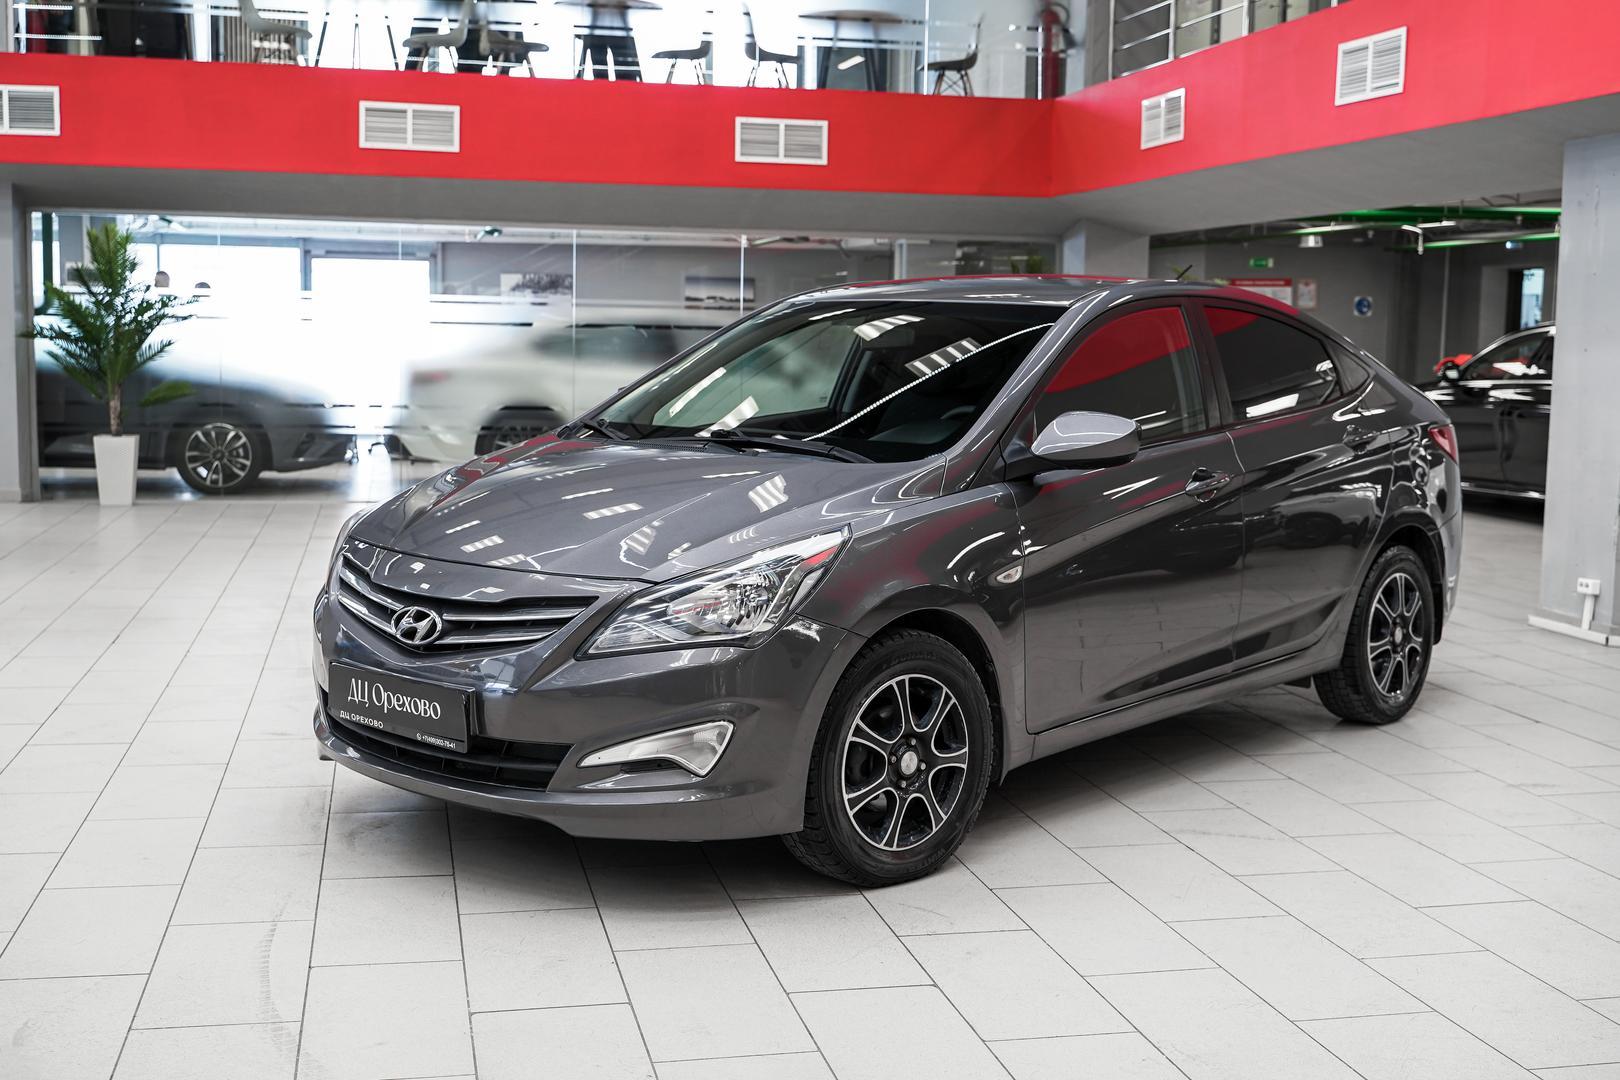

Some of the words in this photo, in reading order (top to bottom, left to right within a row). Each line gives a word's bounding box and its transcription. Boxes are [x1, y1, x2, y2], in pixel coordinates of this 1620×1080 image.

[347, 678, 369, 707] ДЦ
[372, 683, 441, 719] Орехово
[340, 710, 350, 720] ДЦ
[351, 713, 384, 729] ОРЕХОВО
